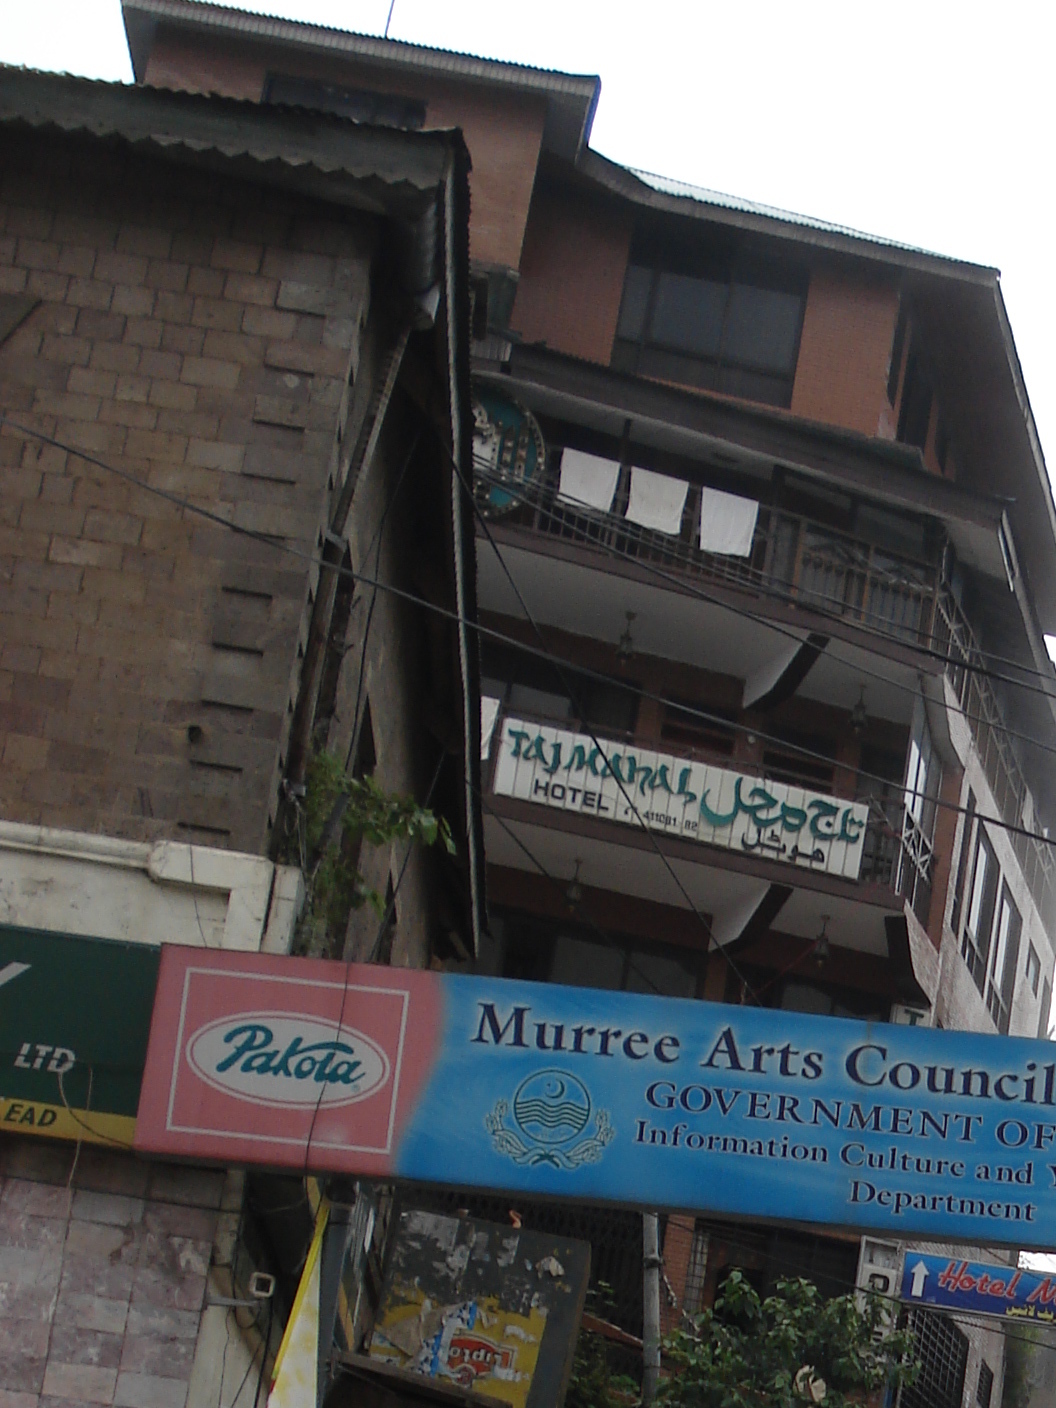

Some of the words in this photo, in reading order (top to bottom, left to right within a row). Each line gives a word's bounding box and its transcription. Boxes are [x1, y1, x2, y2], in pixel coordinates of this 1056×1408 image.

[534, 779, 609, 811] HOTEL
[13, 1043, 76, 1073] LTD
[471, 1002, 681, 1064] Murree
[700, 1027, 824, 1080] Arts
[845, 1044, 1056, 1106] Council
[646, 1081, 983, 1143] GOVERNMENT
[996, 1119, 1056, 1150] OF
[636, 1120, 828, 1162] Information
[840, 1143, 966, 1177] Culture
[975, 1162, 1033, 1185] and
[850, 1180, 1037, 1222] Department
[938, 1258, 1021, 1299] Hotel
[449, 1345, 503, 1365] Lipto
